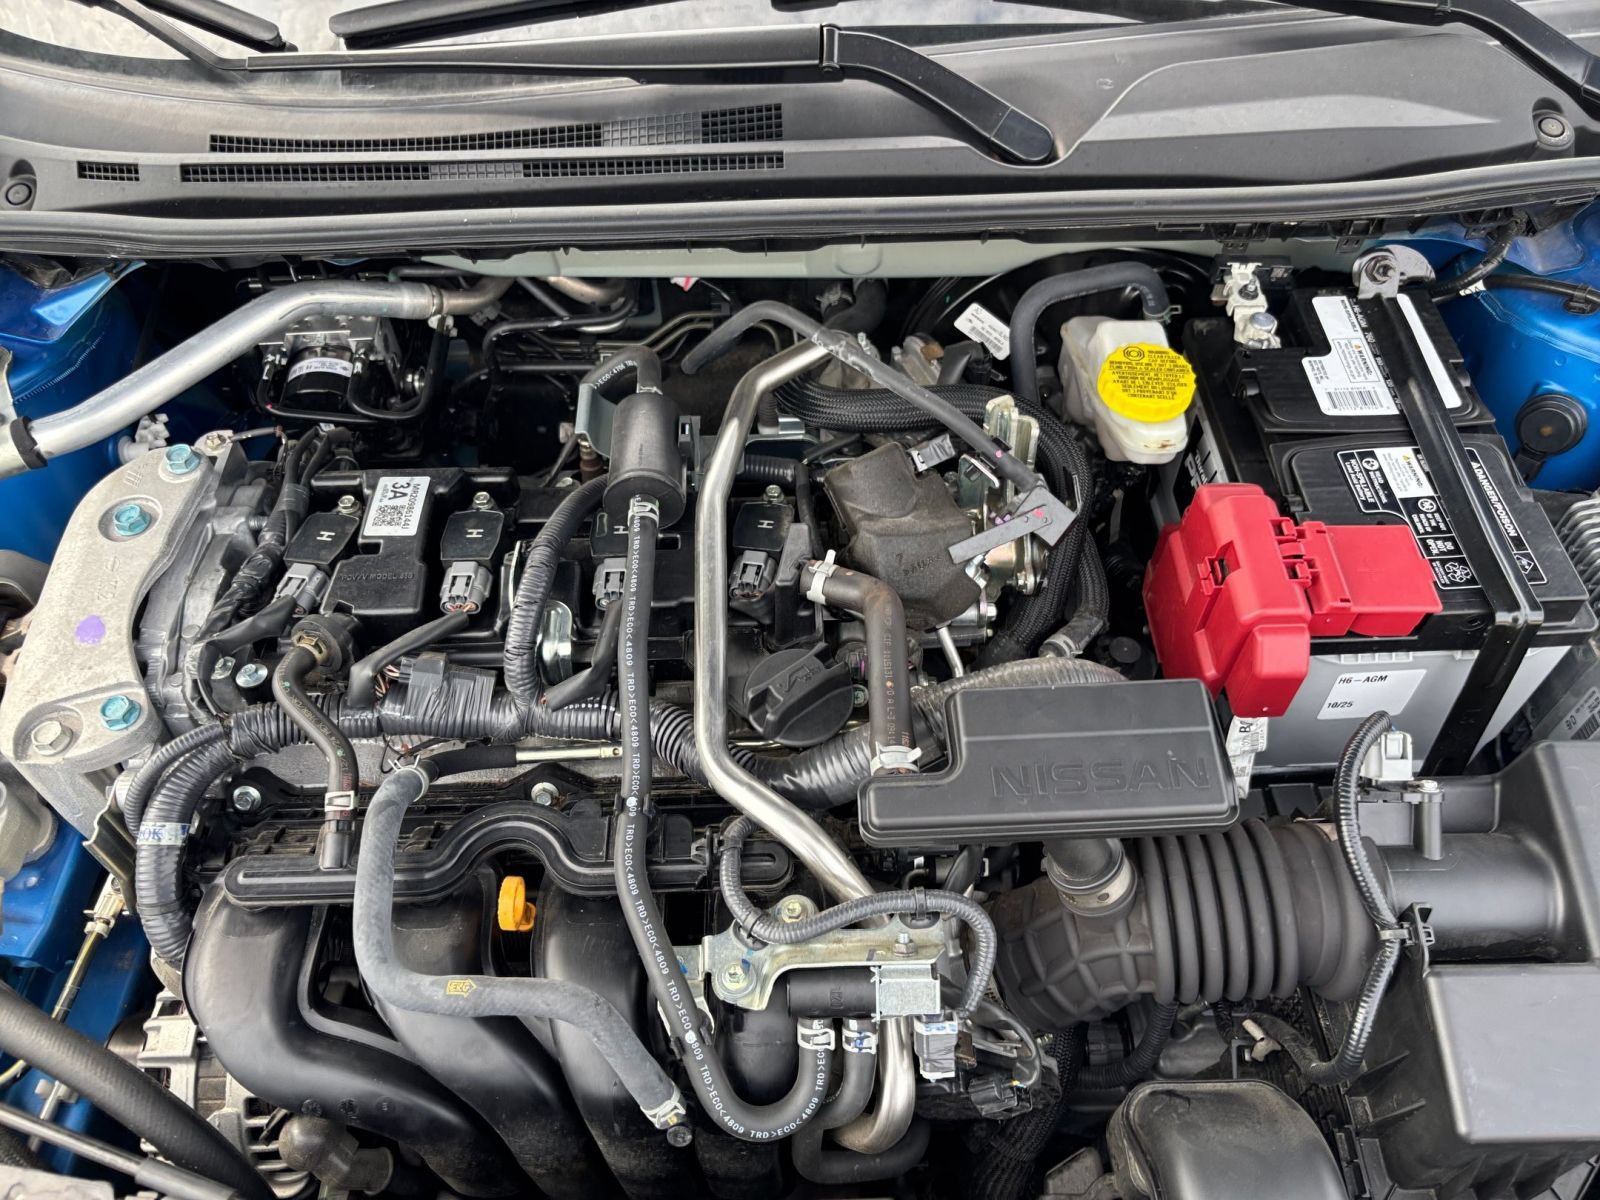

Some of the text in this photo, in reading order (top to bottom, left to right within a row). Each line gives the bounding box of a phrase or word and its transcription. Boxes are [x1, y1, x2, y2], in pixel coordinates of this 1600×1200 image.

[388, 482, 411, 500] 3A
[316, 531, 335, 541] H
[466, 528, 484, 538] H
[757, 519, 775, 529] H
[1435, 540, 1447, 552] NOT
[626, 672, 639, 747] TRD>ECO<4809
[1327, 700, 1353, 709] 10/25
[629, 753, 640, 817] TRD>ECO<09
[990, 758, 1211, 798] NISSAN
[624, 824, 639, 896] TRD>ECO<4809
[634, 898, 670, 975] TRD>ECO<4809
[666, 979, 704, 1061] TRD>ECO809
[699, 1063, 745, 1134] TRD>ECO<4809
[750, 1097, 819, 1139] TRD>ECO<4809
